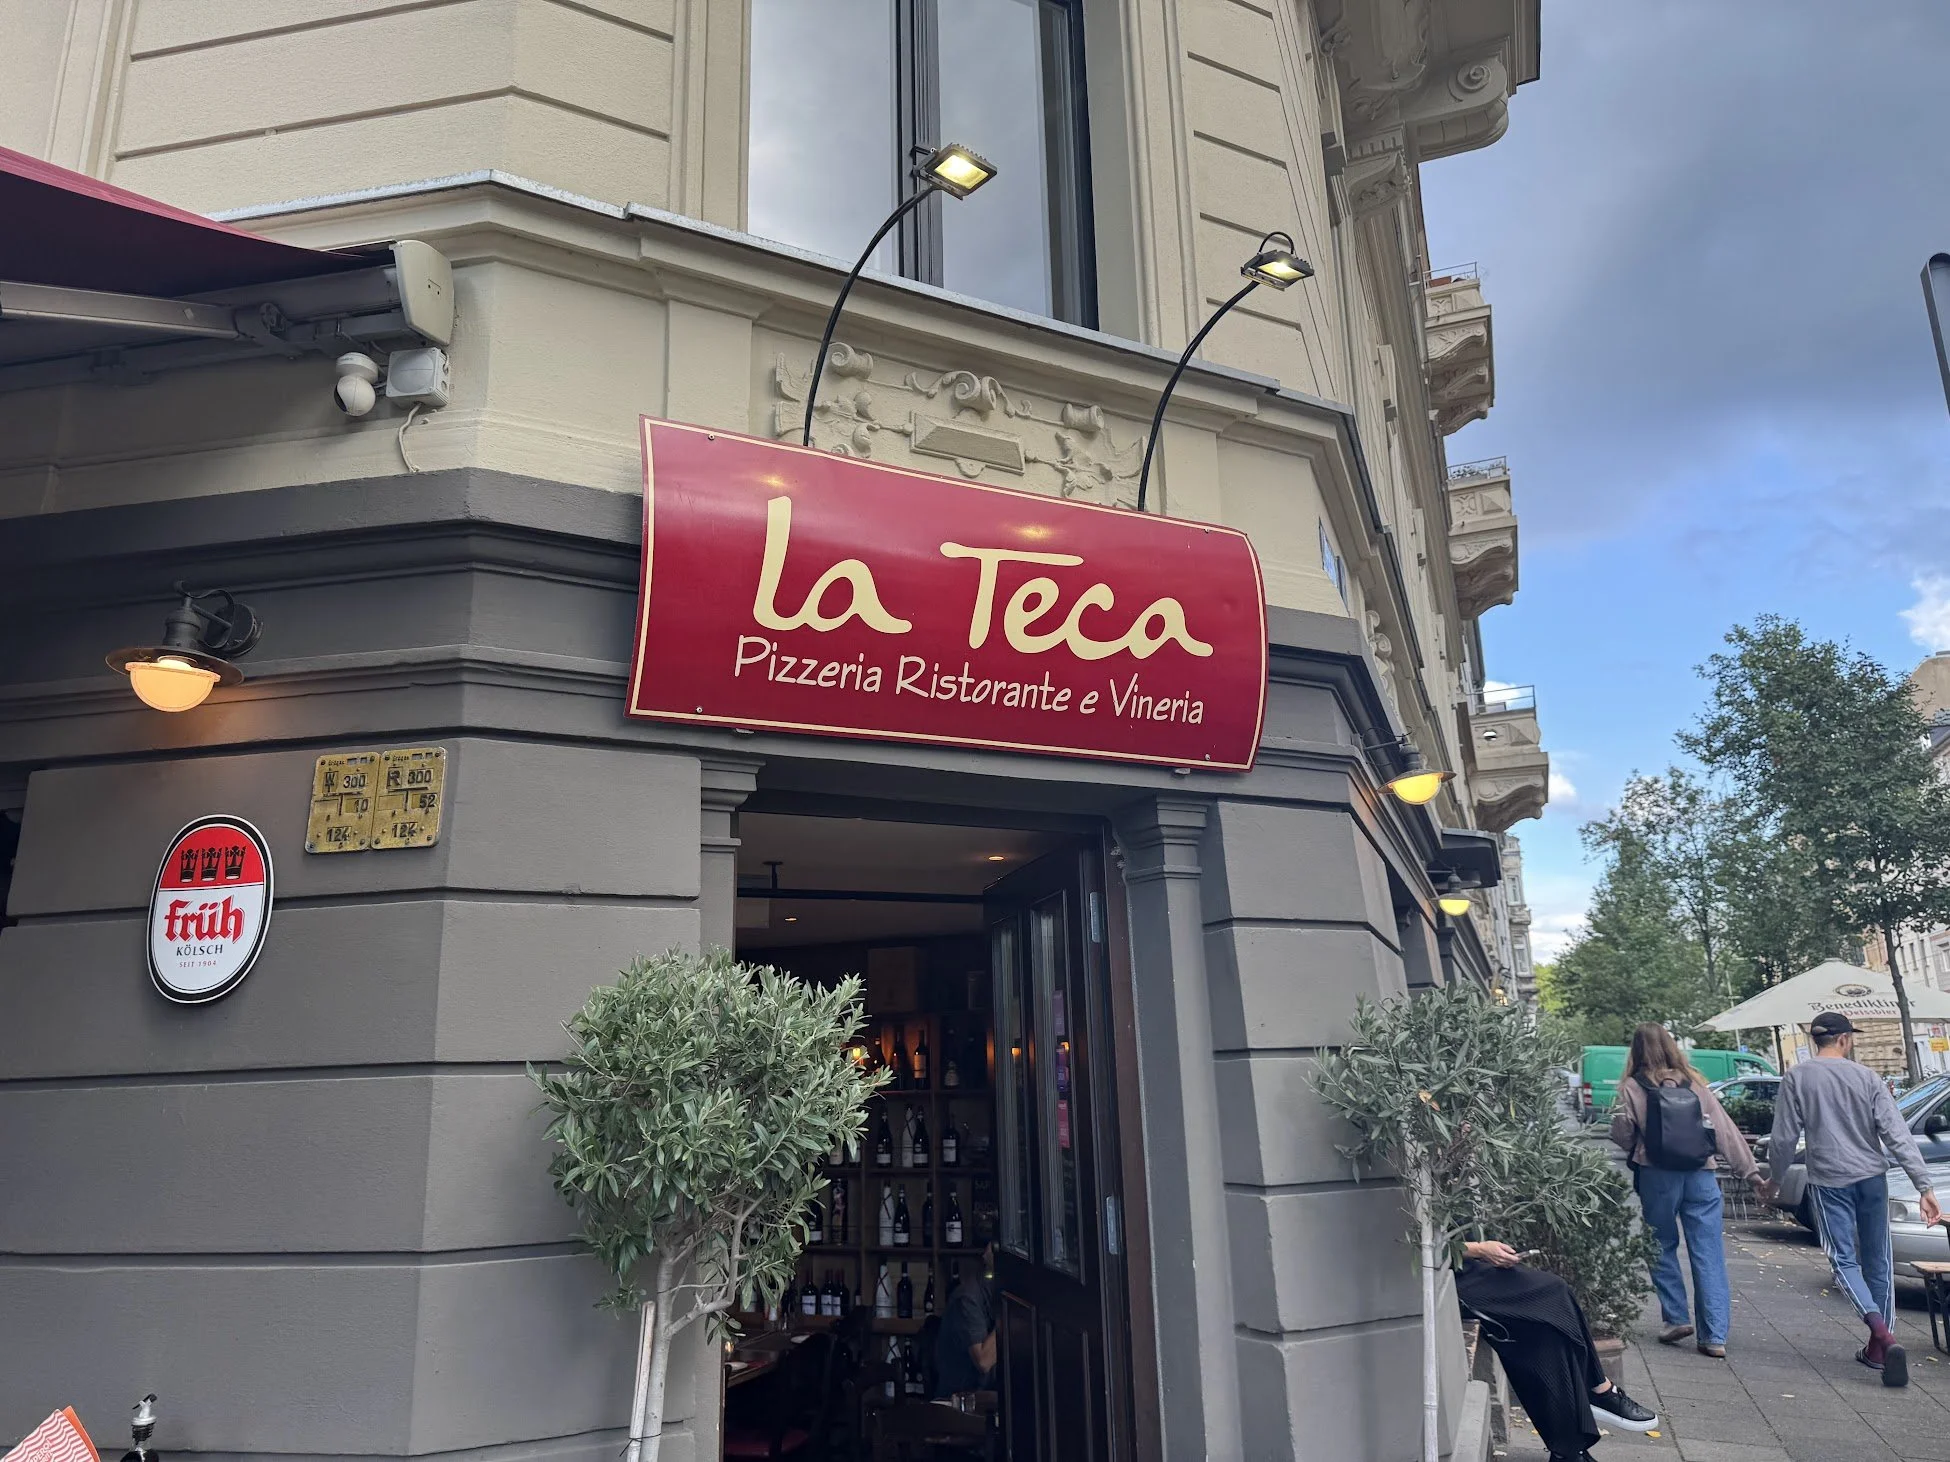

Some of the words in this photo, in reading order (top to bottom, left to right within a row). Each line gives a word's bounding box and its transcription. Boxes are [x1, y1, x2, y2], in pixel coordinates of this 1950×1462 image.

[939, 541, 1214, 661] Teca
[734, 634, 883, 693] Pizzeria
[895, 654, 1072, 712] Ristorante
[1079, 690, 1099, 714] e
[1109, 672, 1204, 724] Vineria
[343, 774, 366, 788] 300
[386, 769, 401, 787] R
[408, 769, 432, 785] 300
[420, 794, 436, 808] 52
[176, 944, 223, 956] KÖLSCH
[1808, 999, 1916, 1013] Benediktinr
